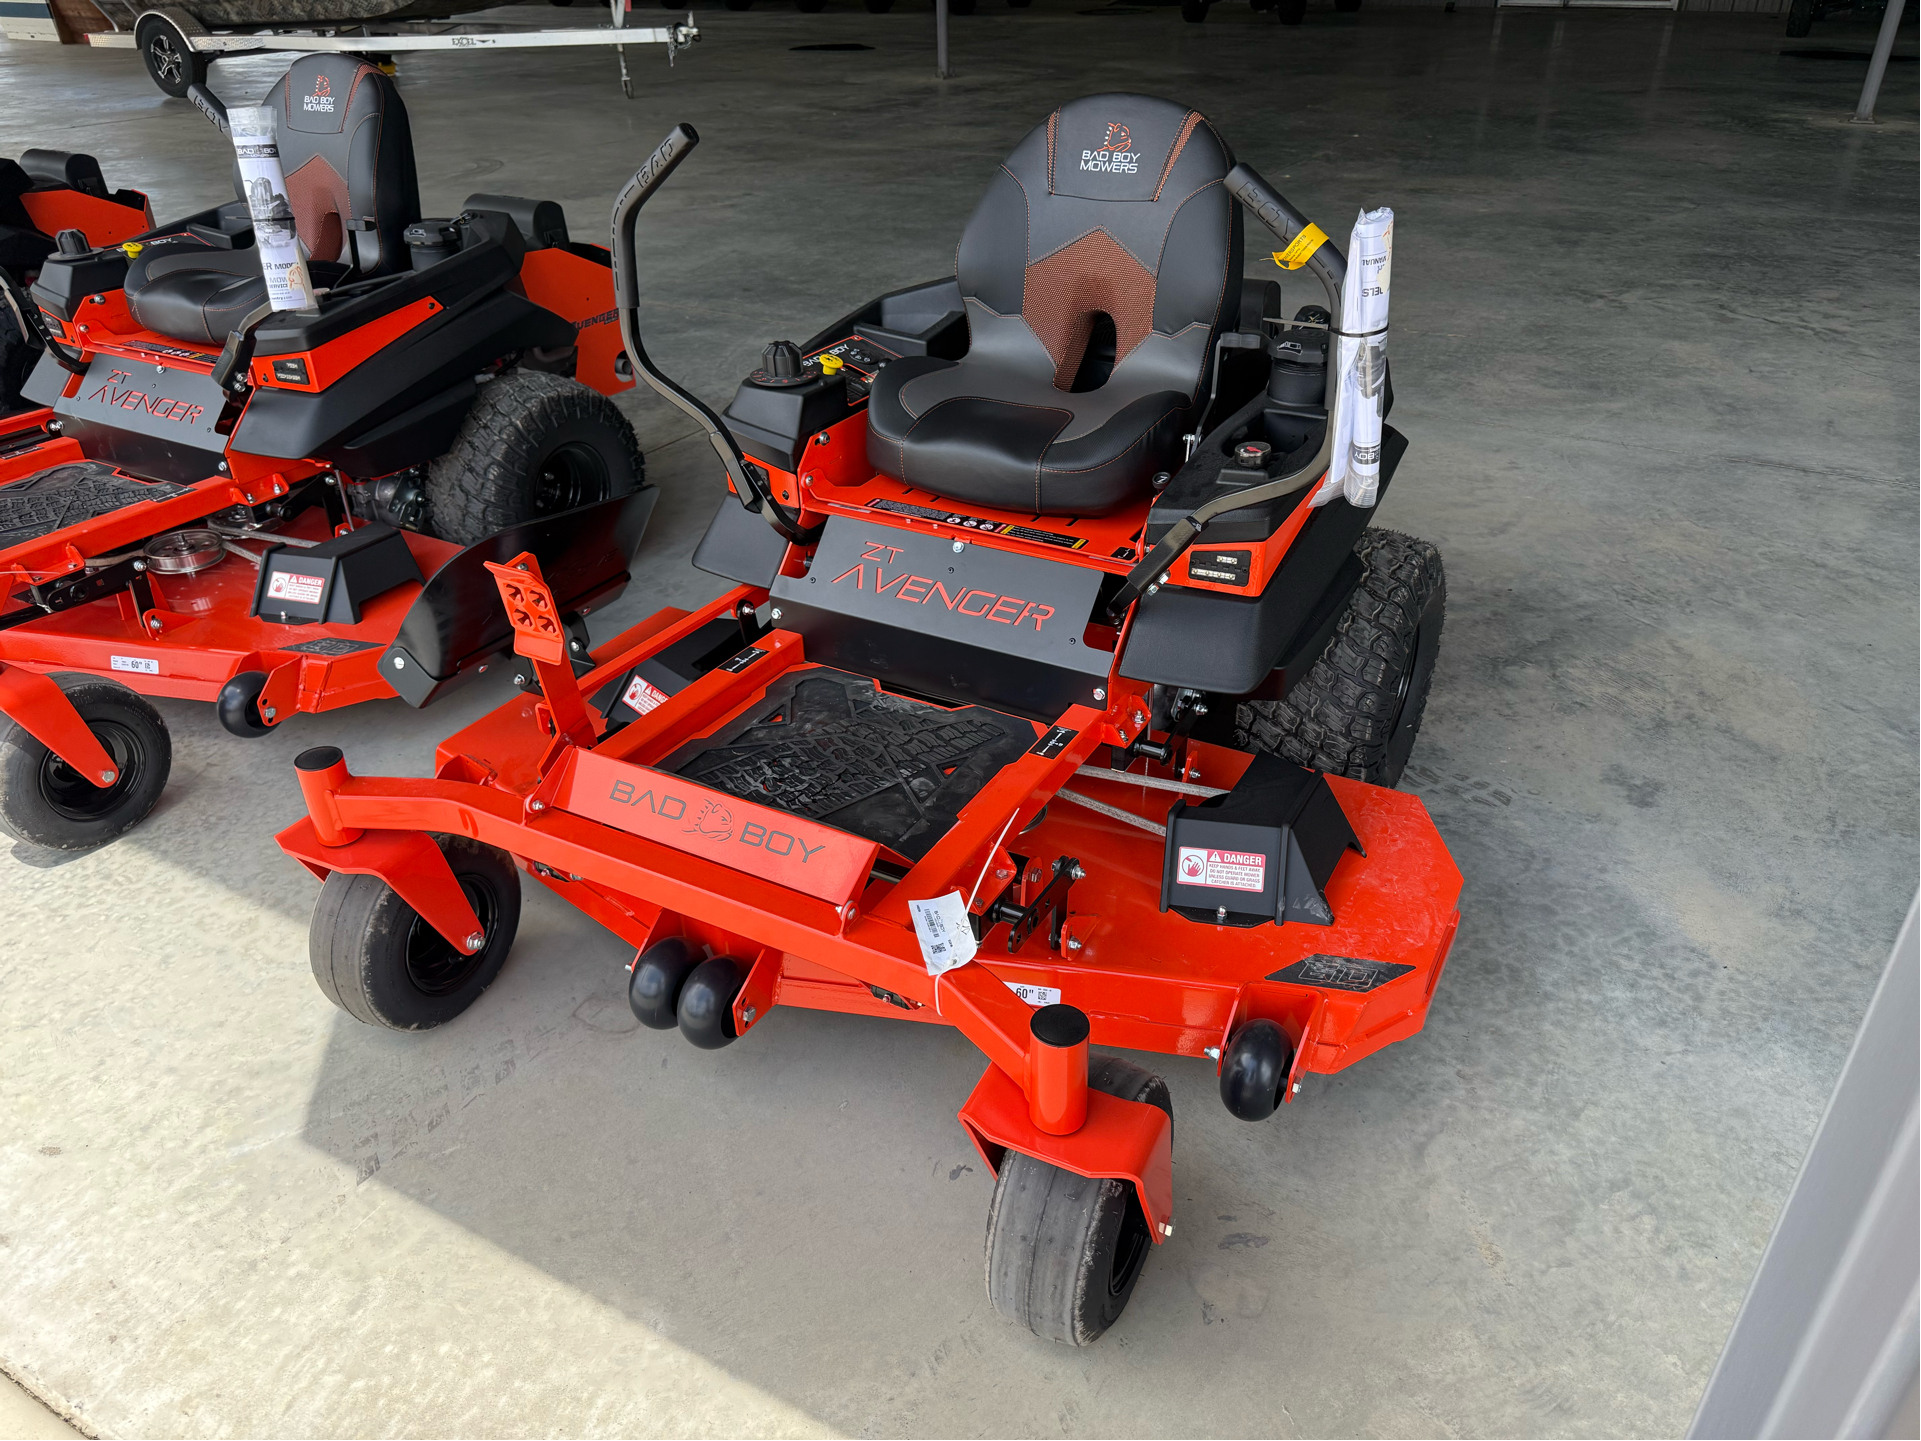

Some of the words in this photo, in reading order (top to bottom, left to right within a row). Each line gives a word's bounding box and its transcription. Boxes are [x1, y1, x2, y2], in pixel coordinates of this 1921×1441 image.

[304, 96, 319, 104] BAD
[320, 96, 335, 105] BOY
[303, 104, 335, 113] MOWERS
[636, 138, 674, 188] BAD
[1082, 150, 1109, 161] BAD
[1112, 152, 1141, 162] BOY
[1080, 160, 1139, 174] MOWERS
[1236, 181, 1295, 242] BOY
[829, 343, 850, 356] BOY
[107, 369, 132, 384] ZT
[88, 385, 205, 424] AVENGER
[860, 541, 904, 564] ZT
[298, 576, 323, 586] DANGER
[831, 563, 1056, 632] AVENGER
[609, 779, 687, 820] BAD
[740, 821, 826, 863] BOY
[1224, 853, 1262, 866] DANGER
